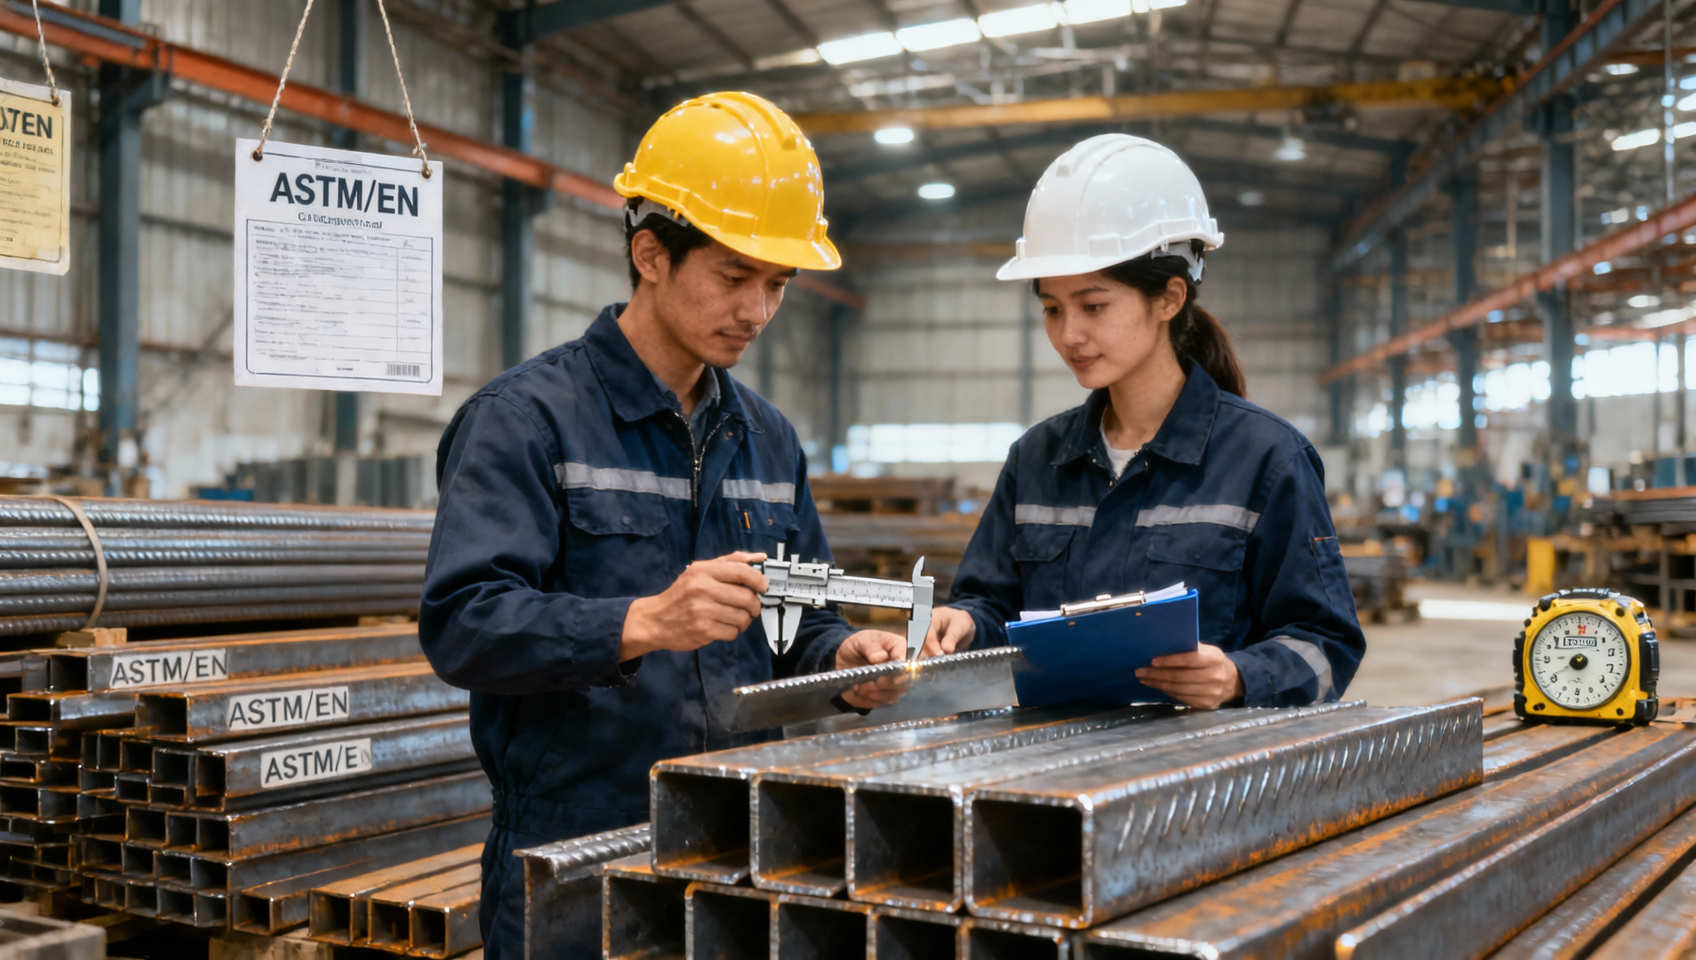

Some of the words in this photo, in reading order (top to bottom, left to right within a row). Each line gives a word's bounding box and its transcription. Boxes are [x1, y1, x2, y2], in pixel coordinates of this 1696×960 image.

[269, 172, 419, 217] ASTM/EN
[111, 651, 227, 686] ASTM/EN
[229, 690, 348, 727] ASTM/EN
